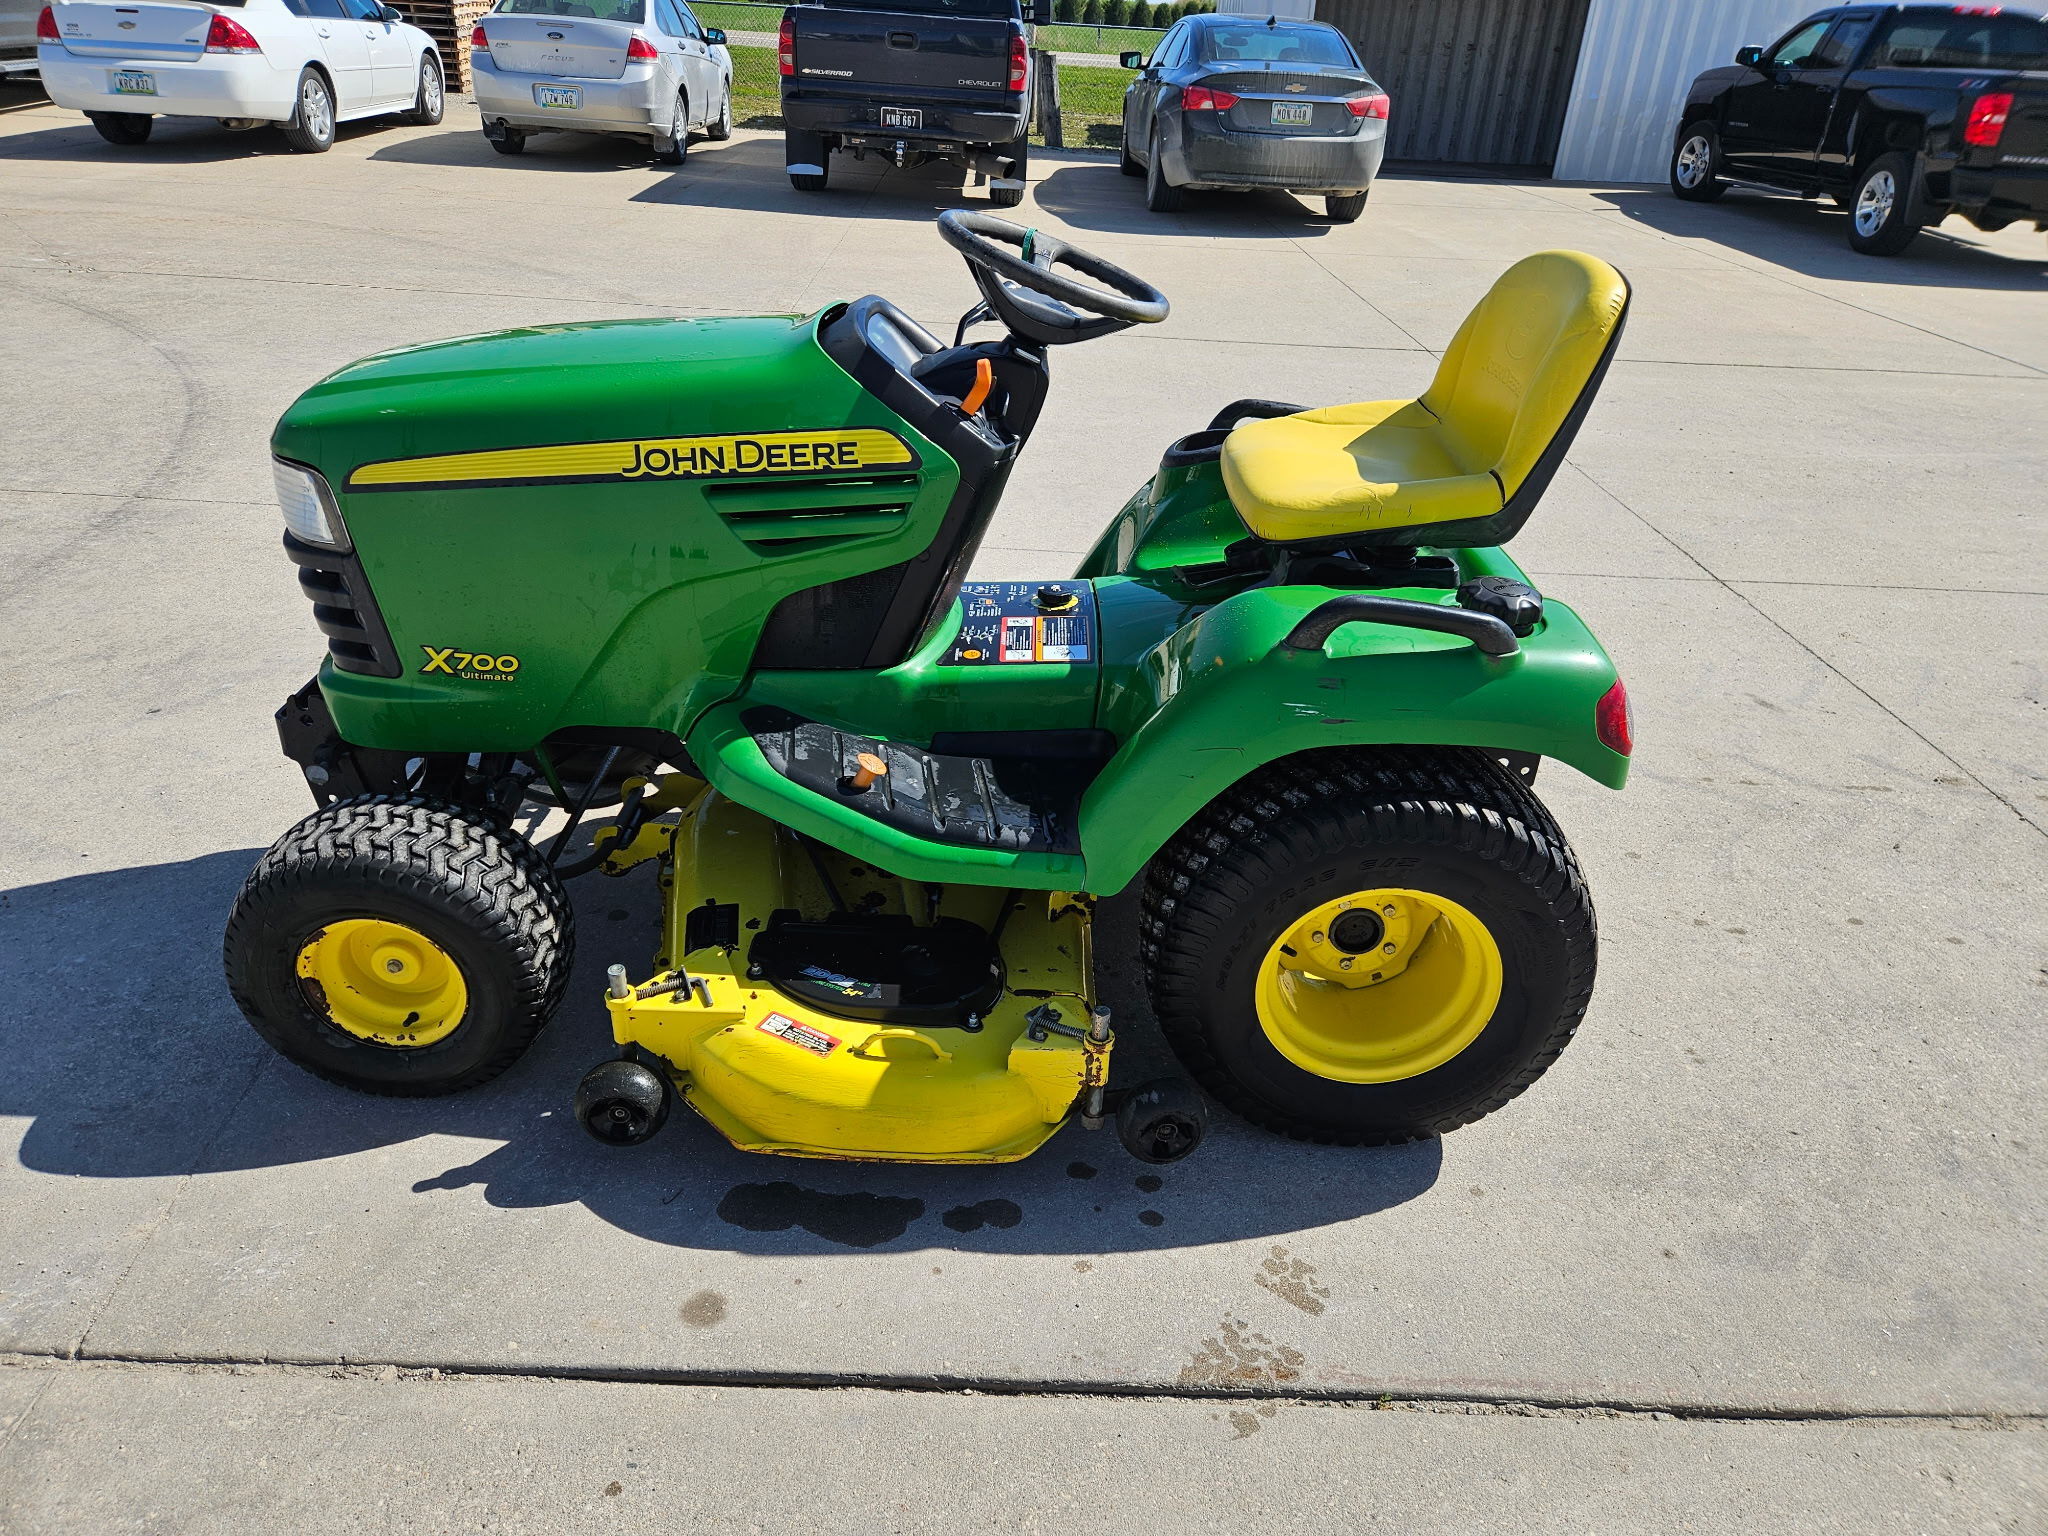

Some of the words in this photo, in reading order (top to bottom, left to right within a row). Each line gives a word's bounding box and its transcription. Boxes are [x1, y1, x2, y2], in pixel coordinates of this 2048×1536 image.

[541, 54, 575, 62] FOCUS
[811, 68, 854, 77] SILVERADO
[118, 78, 133, 89] KRC
[958, 79, 1002, 88] CHEVROLET
[902, 115, 917, 127] 667
[622, 443, 725, 474] JOHN
[734, 440, 859, 468] DEERE
[421, 646, 519, 674] X700
[461, 671, 514, 682] Ultimate
